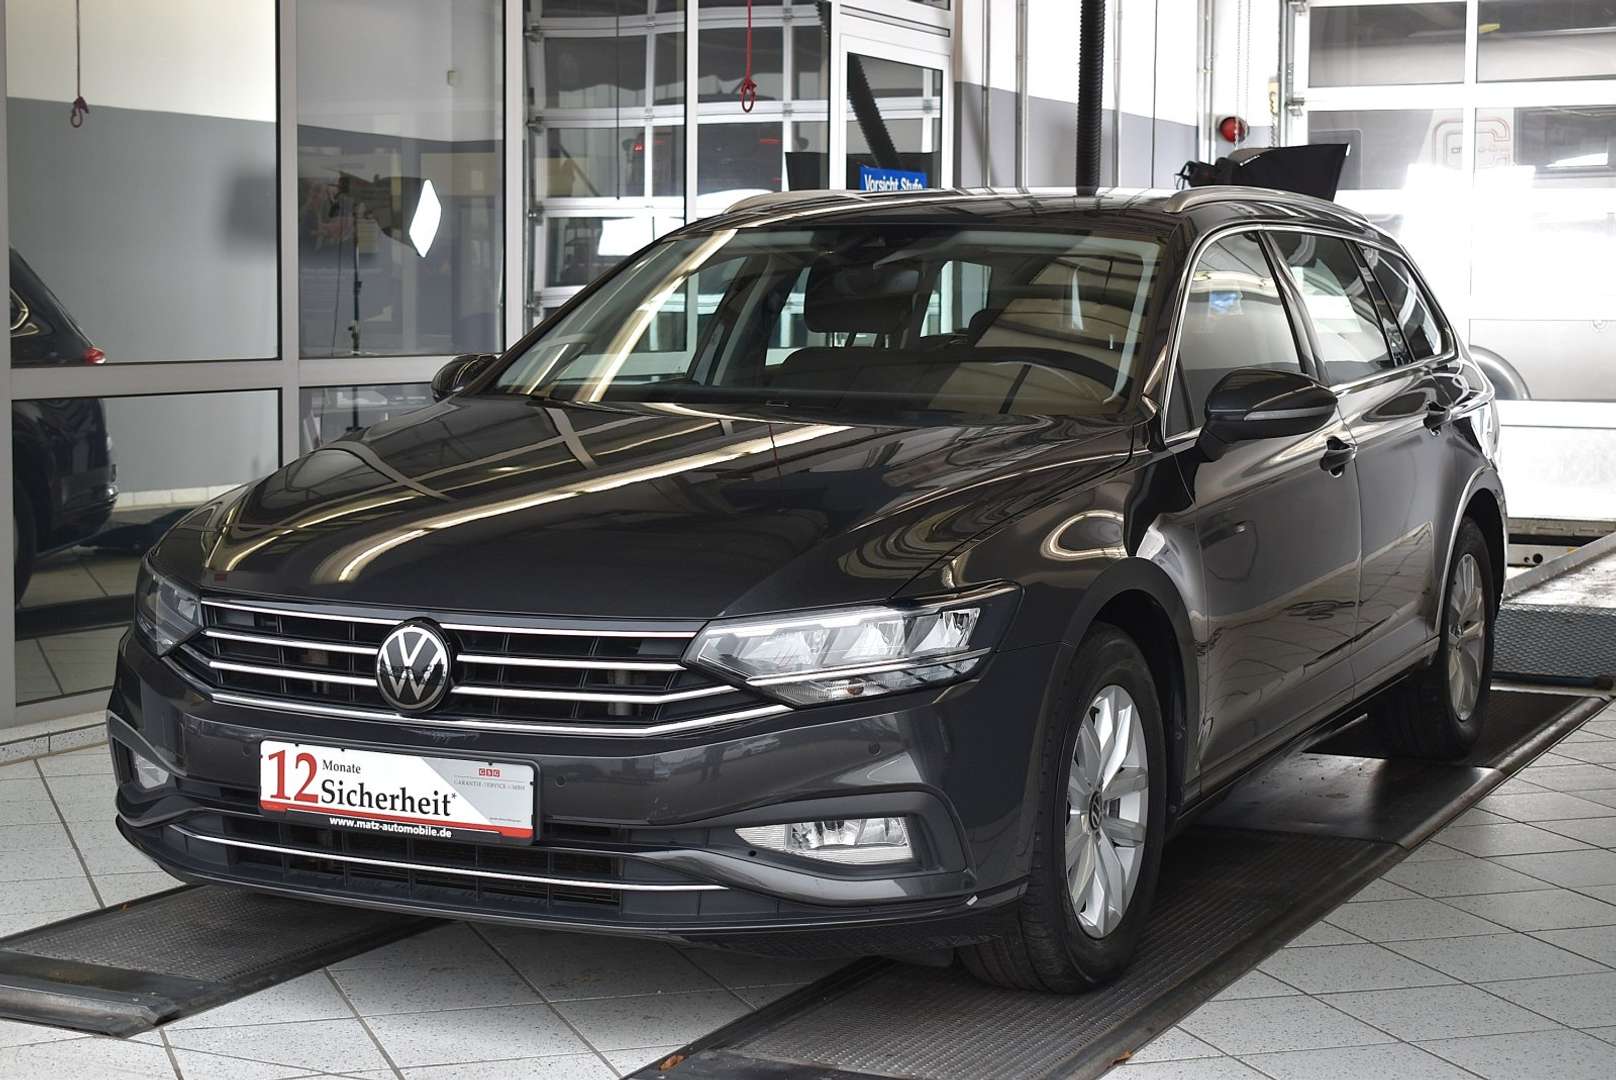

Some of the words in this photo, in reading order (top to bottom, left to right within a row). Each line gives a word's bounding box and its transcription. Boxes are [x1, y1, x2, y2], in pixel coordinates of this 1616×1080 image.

[864, 174, 899, 191] Vorsicht
[322, 759, 361, 774] Monate
[268, 749, 319, 804] 12
[329, 817, 452, 838] www.matz-automobile.de
